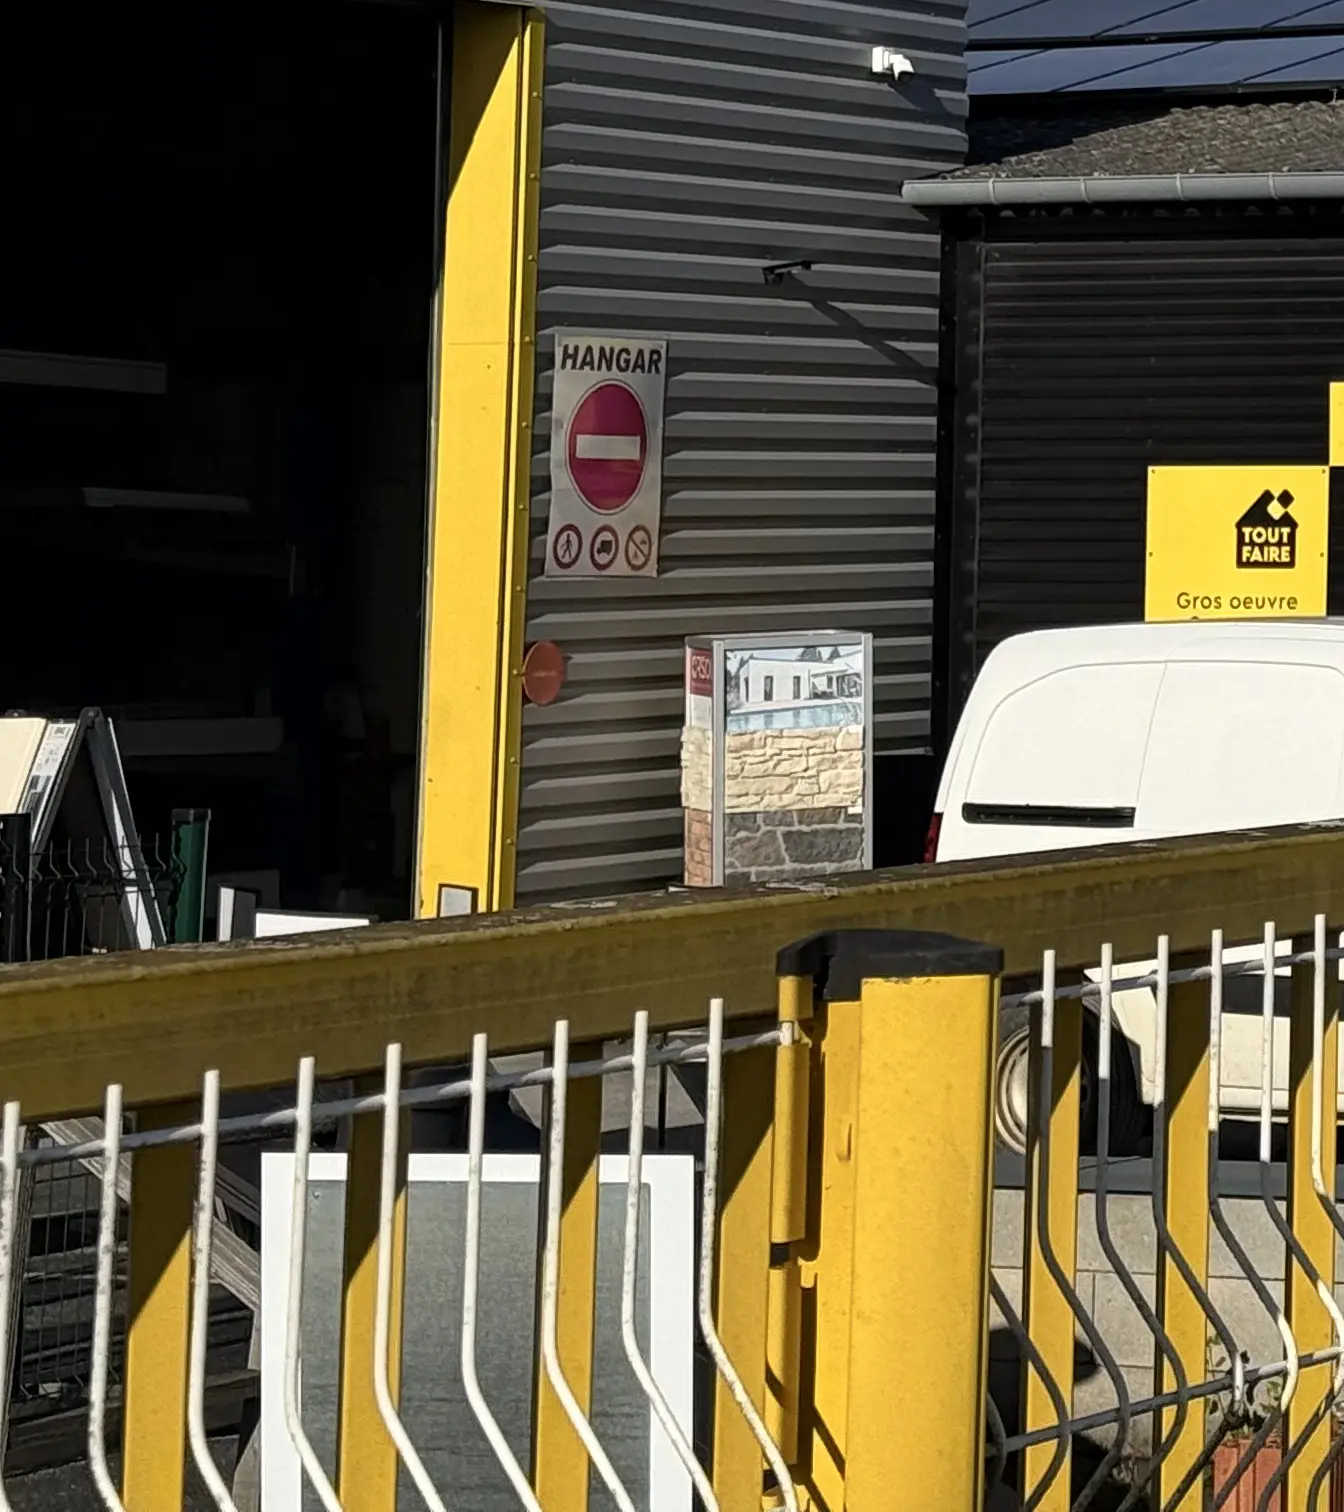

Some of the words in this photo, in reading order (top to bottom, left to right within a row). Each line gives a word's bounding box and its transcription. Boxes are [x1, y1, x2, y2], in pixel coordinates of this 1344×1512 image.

[561, 344, 662, 375] HANGAR
[1241, 526, 1290, 544] TOUT
[1241, 546, 1291, 564] FAIRE
[1176, 591, 1222, 611] Gros
[1229, 595, 1298, 610] oeuvre
